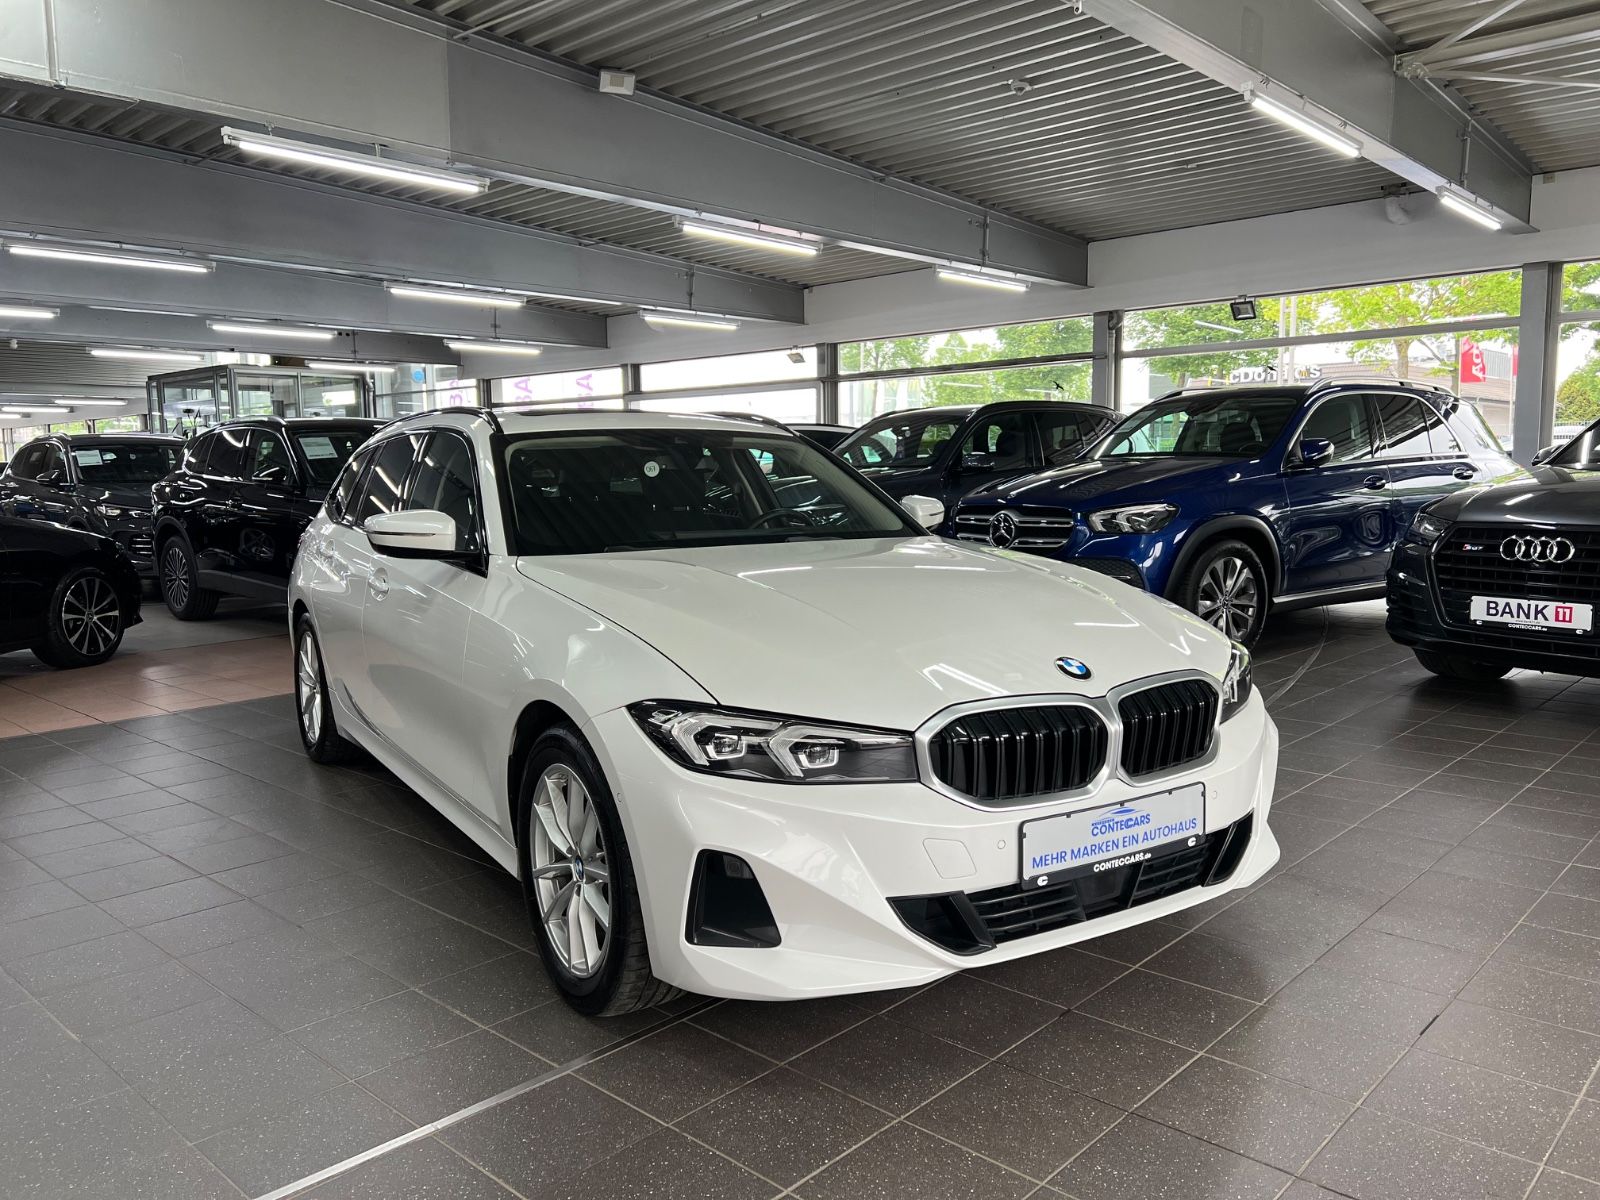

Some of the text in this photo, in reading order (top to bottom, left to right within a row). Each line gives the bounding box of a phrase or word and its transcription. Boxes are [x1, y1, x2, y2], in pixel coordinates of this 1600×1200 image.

[1486, 600, 1572, 622] BANK 11
[1091, 813, 1151, 837] CONTECCARS
[1032, 818, 1197, 869] MEHR MARKEN EIN AUTOHAUS
[1093, 852, 1152, 873] CONTECCARS.de
